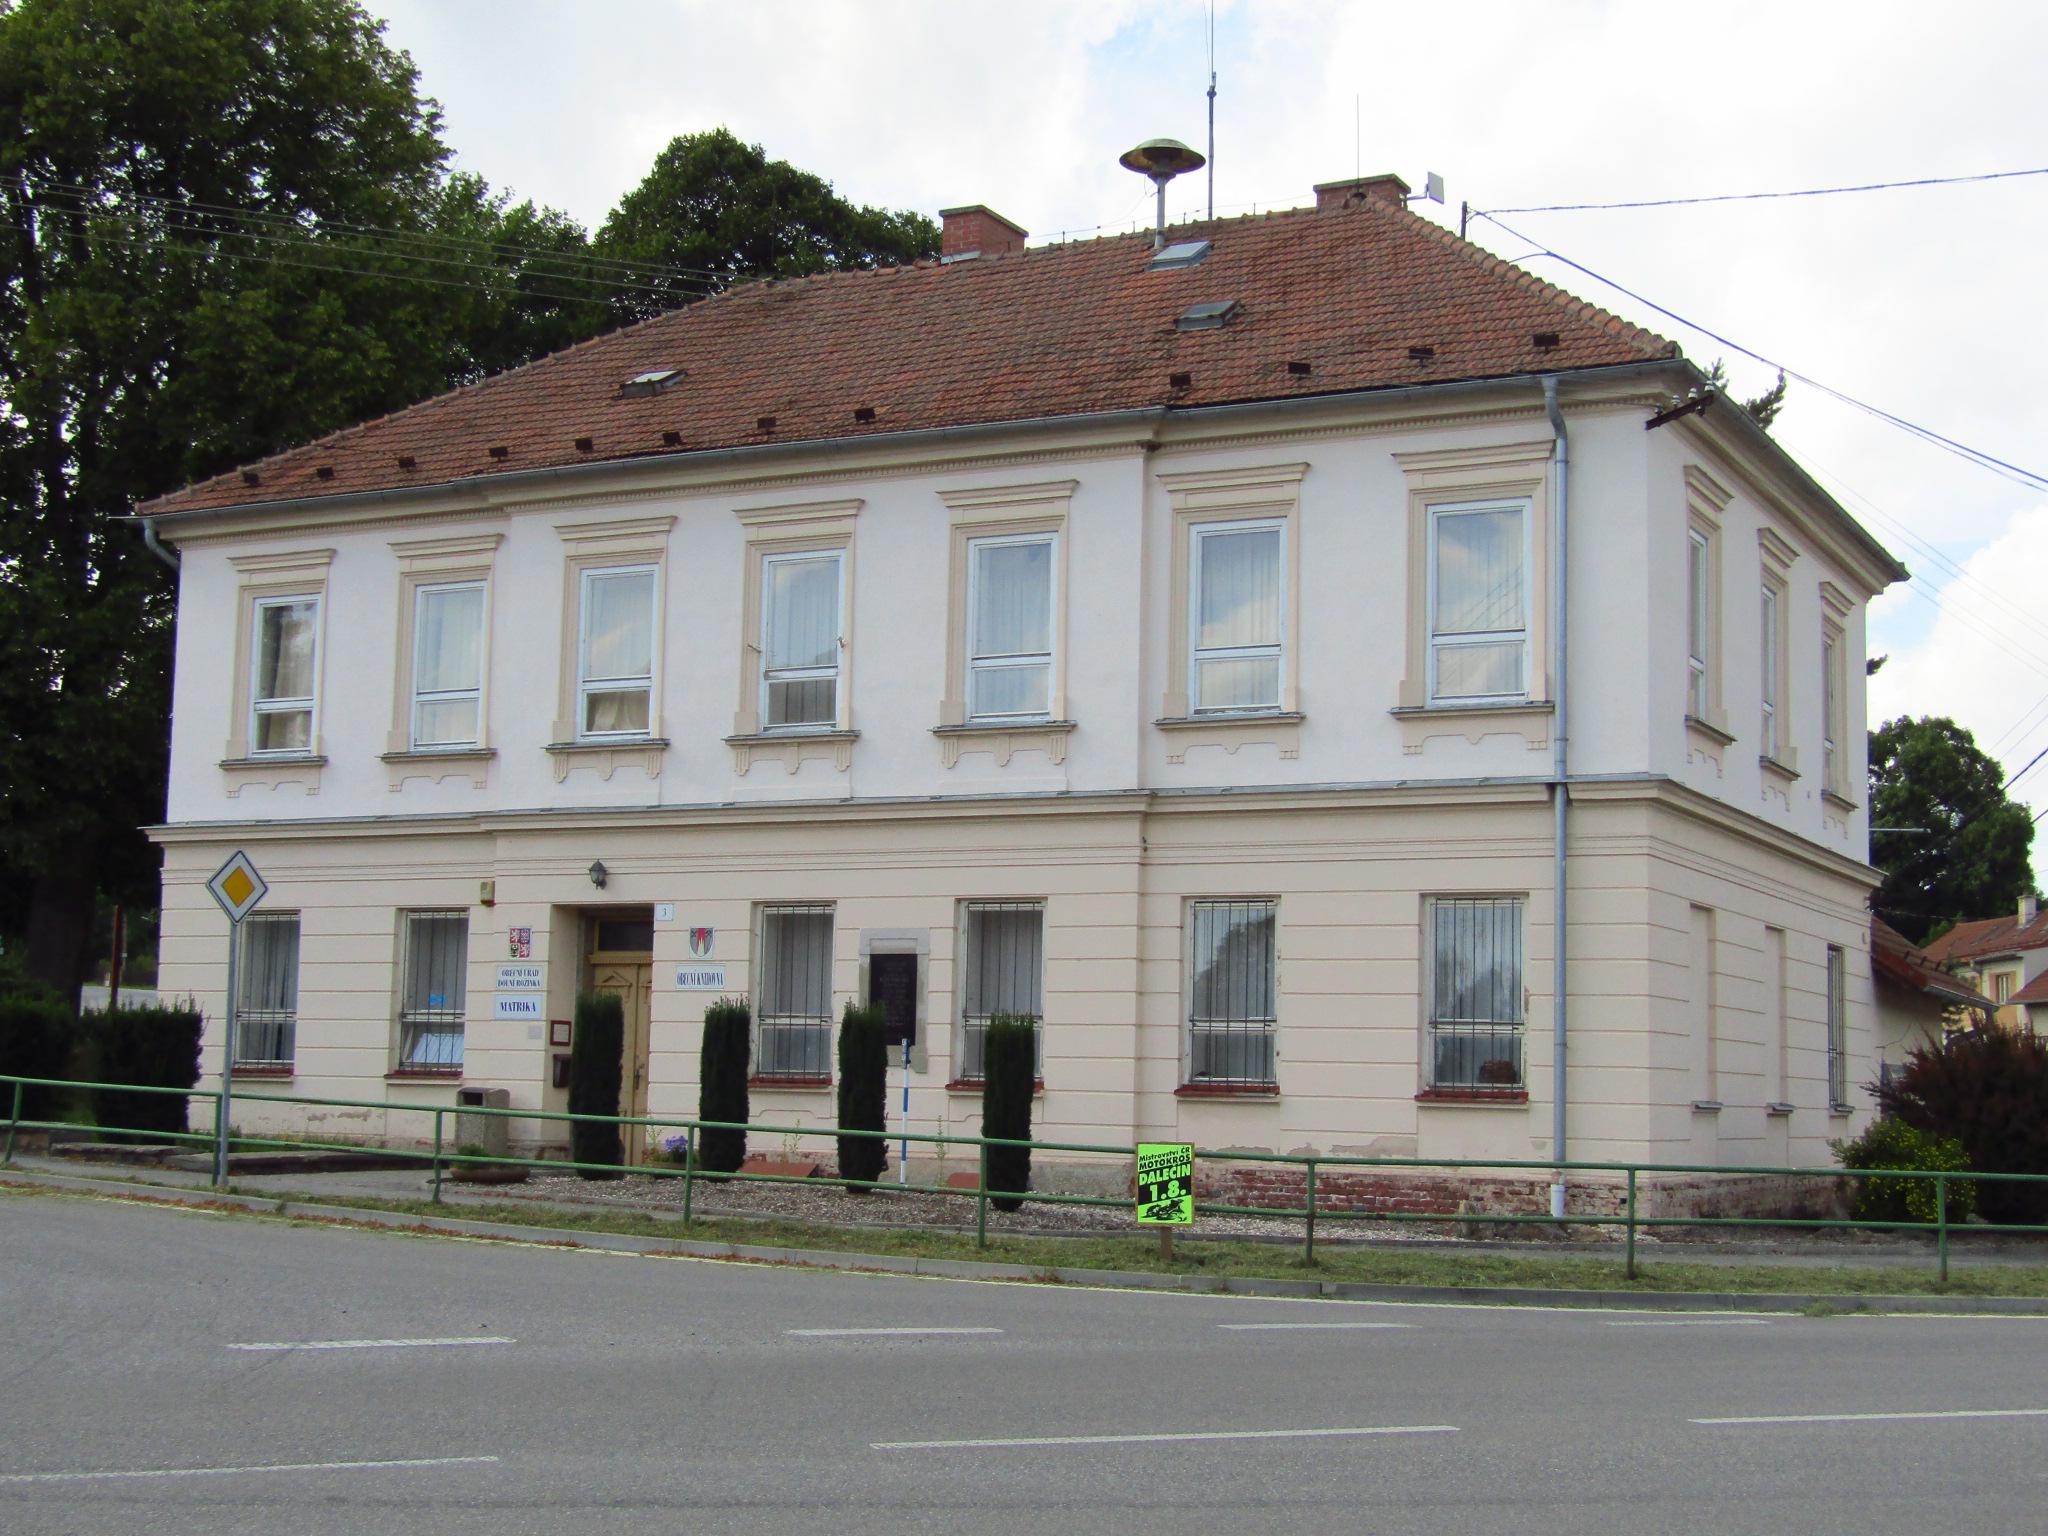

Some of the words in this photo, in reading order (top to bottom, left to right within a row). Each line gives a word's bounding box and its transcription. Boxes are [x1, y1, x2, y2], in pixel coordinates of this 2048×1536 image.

[501, 1001, 536, 1012] MATRIKA
[1139, 1153, 1191, 1171] MOTOKROS
[1149, 1180, 1187, 1202] 1.8.
